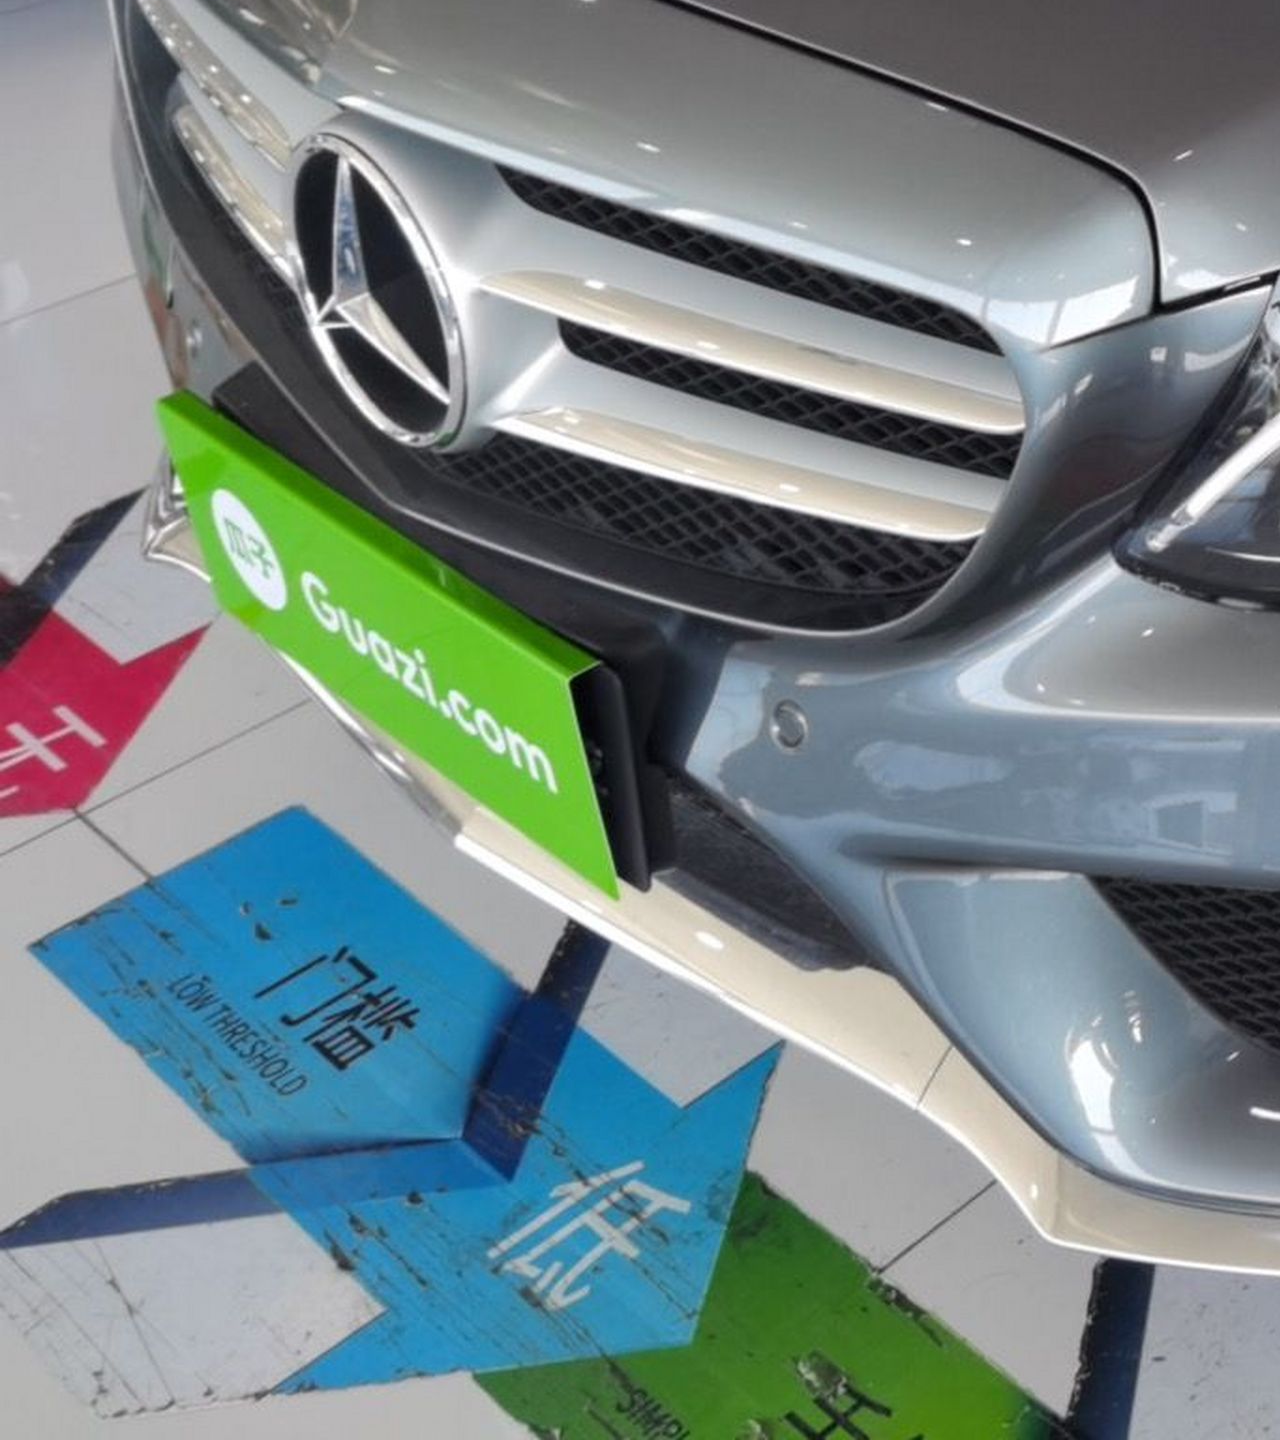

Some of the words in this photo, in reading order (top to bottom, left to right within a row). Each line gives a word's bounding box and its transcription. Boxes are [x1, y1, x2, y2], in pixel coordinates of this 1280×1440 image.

[302, 571, 558, 795] Guazi.com
[167, 972, 220, 1012] LOW
[202, 1004, 308, 1096] THRESHOLD
[254, 946, 420, 1071] 门槛
[487, 1161, 691, 1311] 低
